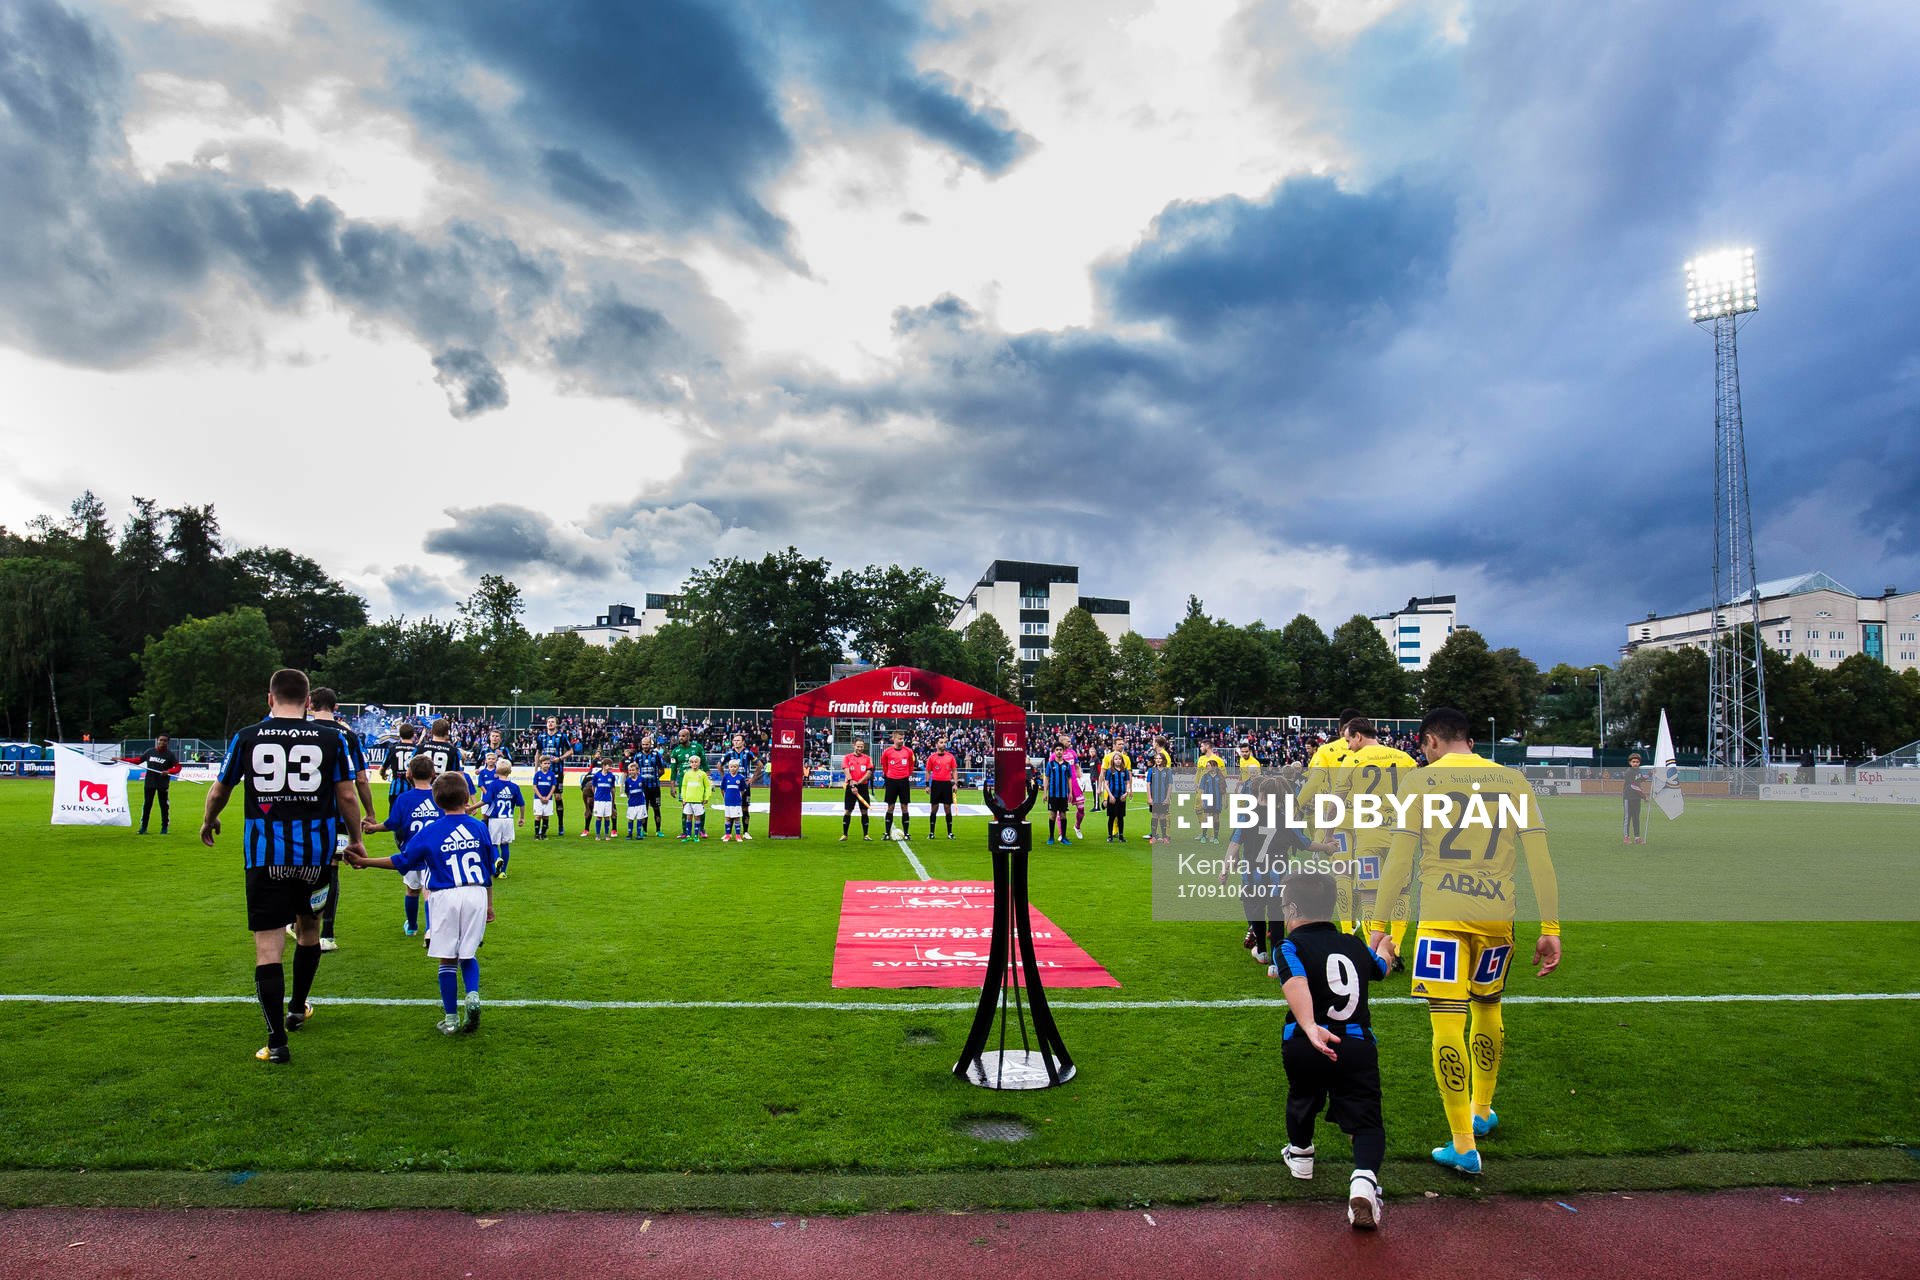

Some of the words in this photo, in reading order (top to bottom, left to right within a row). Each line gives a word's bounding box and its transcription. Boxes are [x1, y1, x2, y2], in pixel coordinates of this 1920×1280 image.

[419, 705, 427, 714] R
[665, 707, 673, 717] Q
[828, 699, 870, 713] Framåt
[872, 700, 890, 714] för
[891, 702, 929, 714] svensk
[930, 701, 974, 715] fotboll!
[257, 728, 288, 736] ÅRSTA
[252, 743, 323, 792] 93
[1858, 771, 1883, 784] Kph
[1362, 763, 1398, 804] 21
[61, 804, 102, 812] SVENSKA
[411, 809, 439, 818] adidas
[1438, 791, 1511, 860] 27
[440, 839, 480, 853] adidas
[1256, 826, 1277, 863] 7
[446, 851, 485, 887] 16
[1437, 873, 1506, 901] ABAX
[1326, 953, 1360, 1021] 9
[1472, 1033, 1495, 1072] ego
[1439, 1045, 1465, 1092] ego
